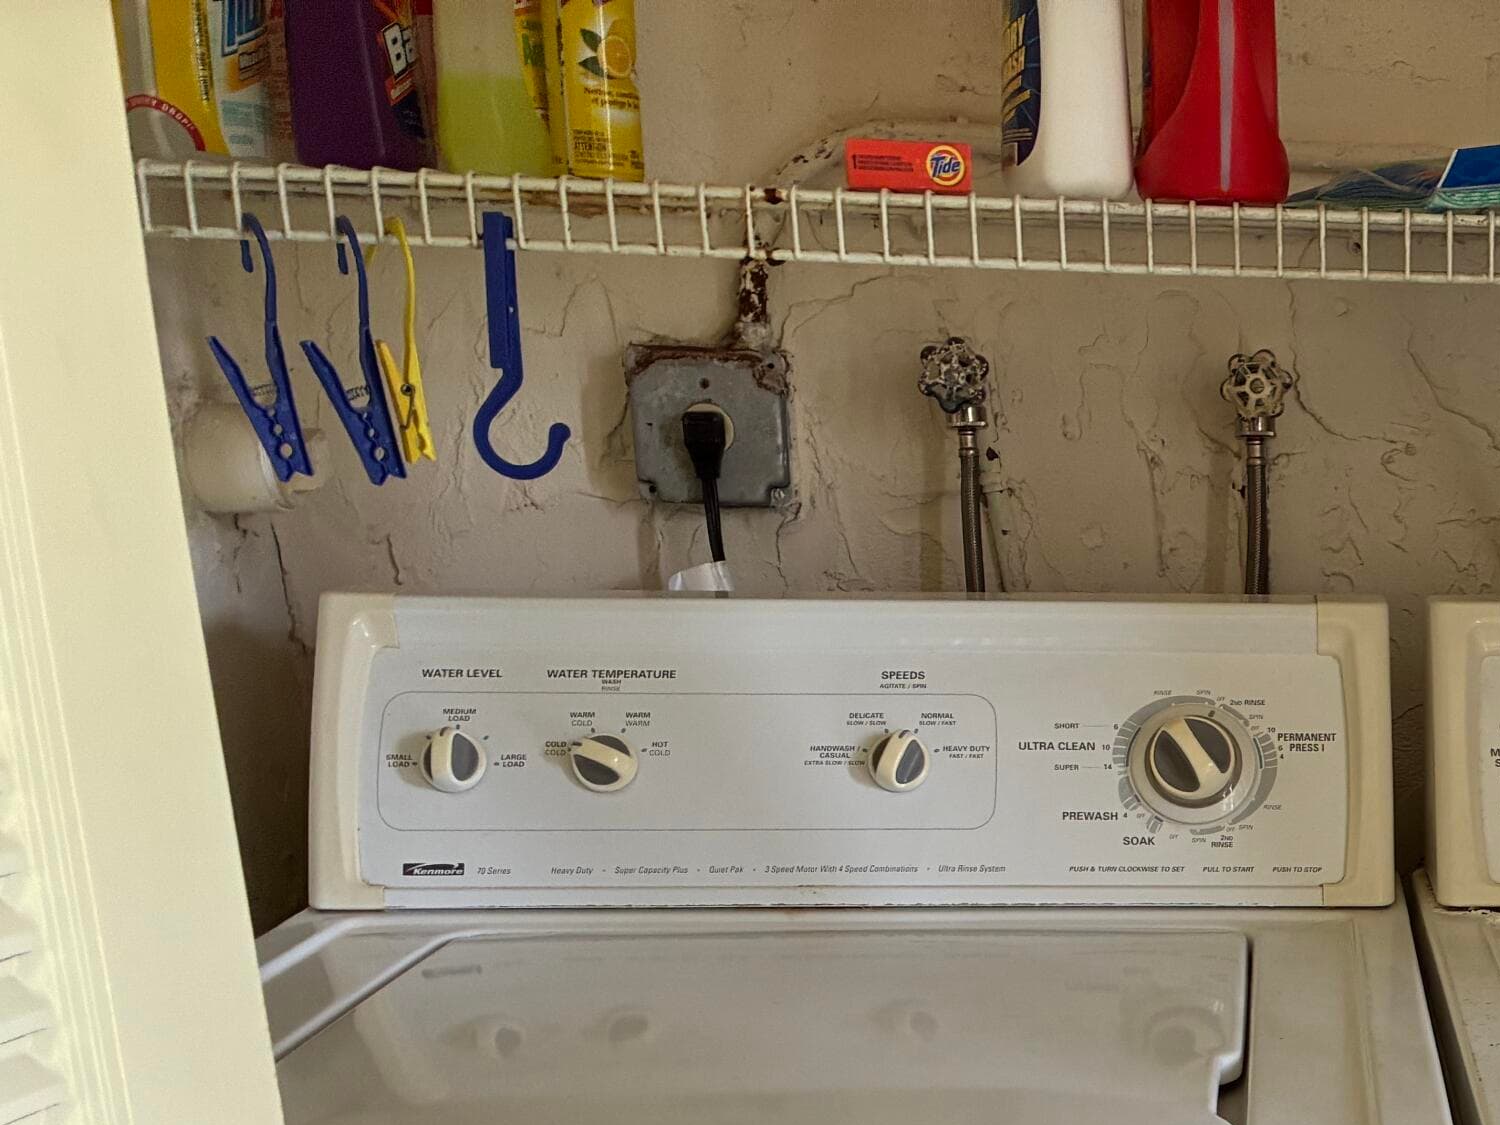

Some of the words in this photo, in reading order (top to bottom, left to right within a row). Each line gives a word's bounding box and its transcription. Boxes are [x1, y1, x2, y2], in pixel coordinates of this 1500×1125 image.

[930, 157, 960, 177] Tide
[422, 669, 463, 678] WATER
[467, 669, 503, 678] LEVEL
[547, 670, 587, 679] WATER
[591, 670, 676, 679] TEMPERATURE
[881, 671, 925, 680] SPEEDS
[1278, 733, 1336, 742] PERMANENT
[1019, 742, 1053, 751] ULTRA
[1057, 742, 1095, 751] CLEAN
[1289, 744, 1319, 752] PRESS
[1062, 812, 1118, 821] PREWASH
[1123, 837, 1155, 846] SOAK
[551, 867, 574, 875] Heavy
[576, 867, 594, 875] Duty
[614, 867, 636, 875] Super
[638, 867, 670, 875] Capacity
[771, 866, 794, 874] Speed
[845, 866, 867, 874] Speed
[869, 865, 918, 873] Combinations
[979, 865, 1006, 874] System
